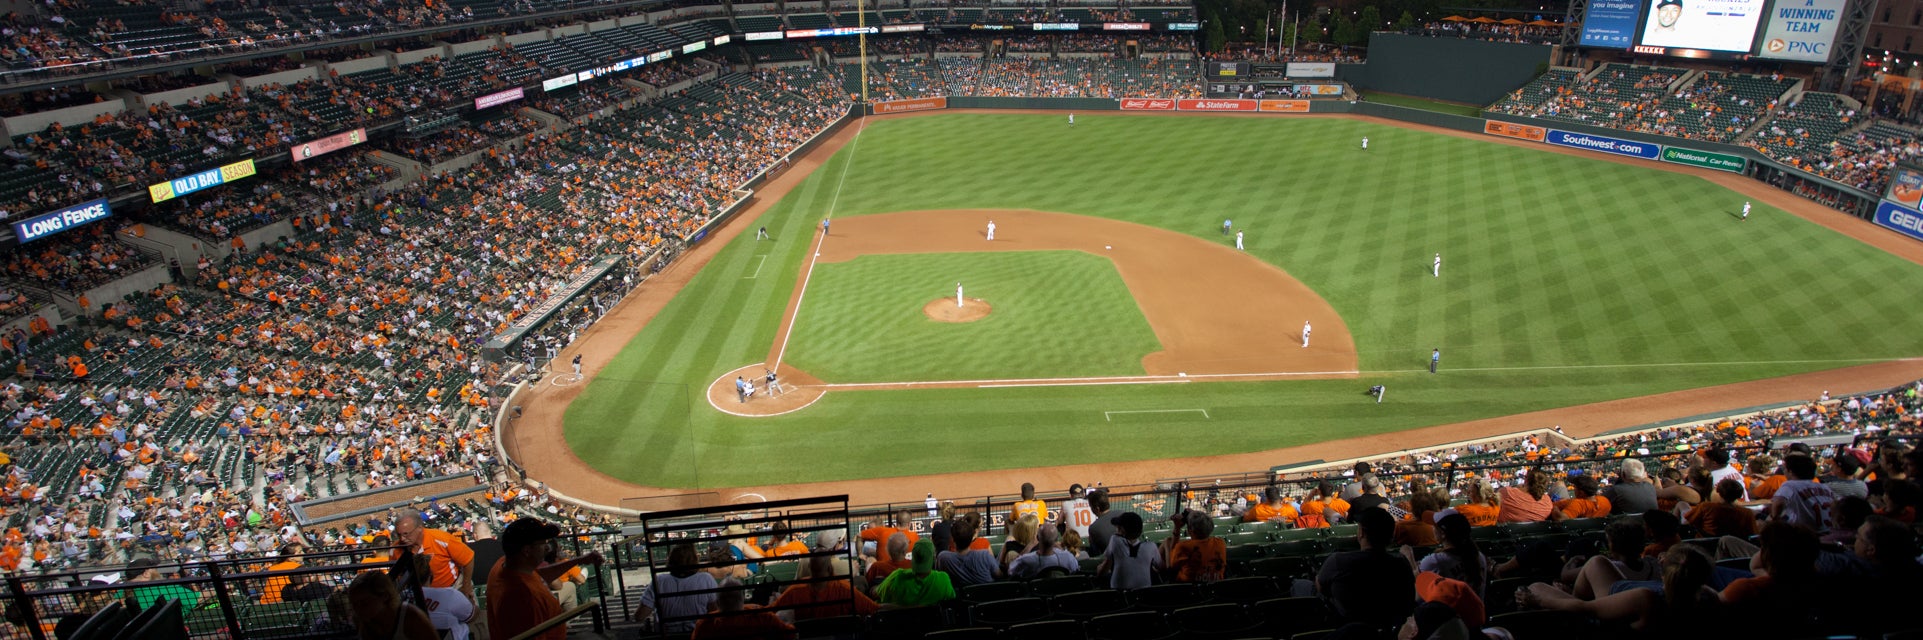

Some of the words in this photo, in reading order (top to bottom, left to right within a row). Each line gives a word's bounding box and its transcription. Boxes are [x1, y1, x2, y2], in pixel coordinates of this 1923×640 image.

[1606, 2, 1634, 10] imagine
[1779, 8, 1835, 20] WINNING
[1786, 22, 1821, 33] TEAM
[1788, 41, 1826, 55] PNC
[1676, 151, 1708, 163] National
[1709, 157, 1722, 165] Car
[175, 177, 198, 194] OLD
[223, 161, 254, 180] SEASON
[21, 216, 63, 239] LONG
[62, 203, 106, 226] FENCE
[1074, 509, 1091, 527] 10
